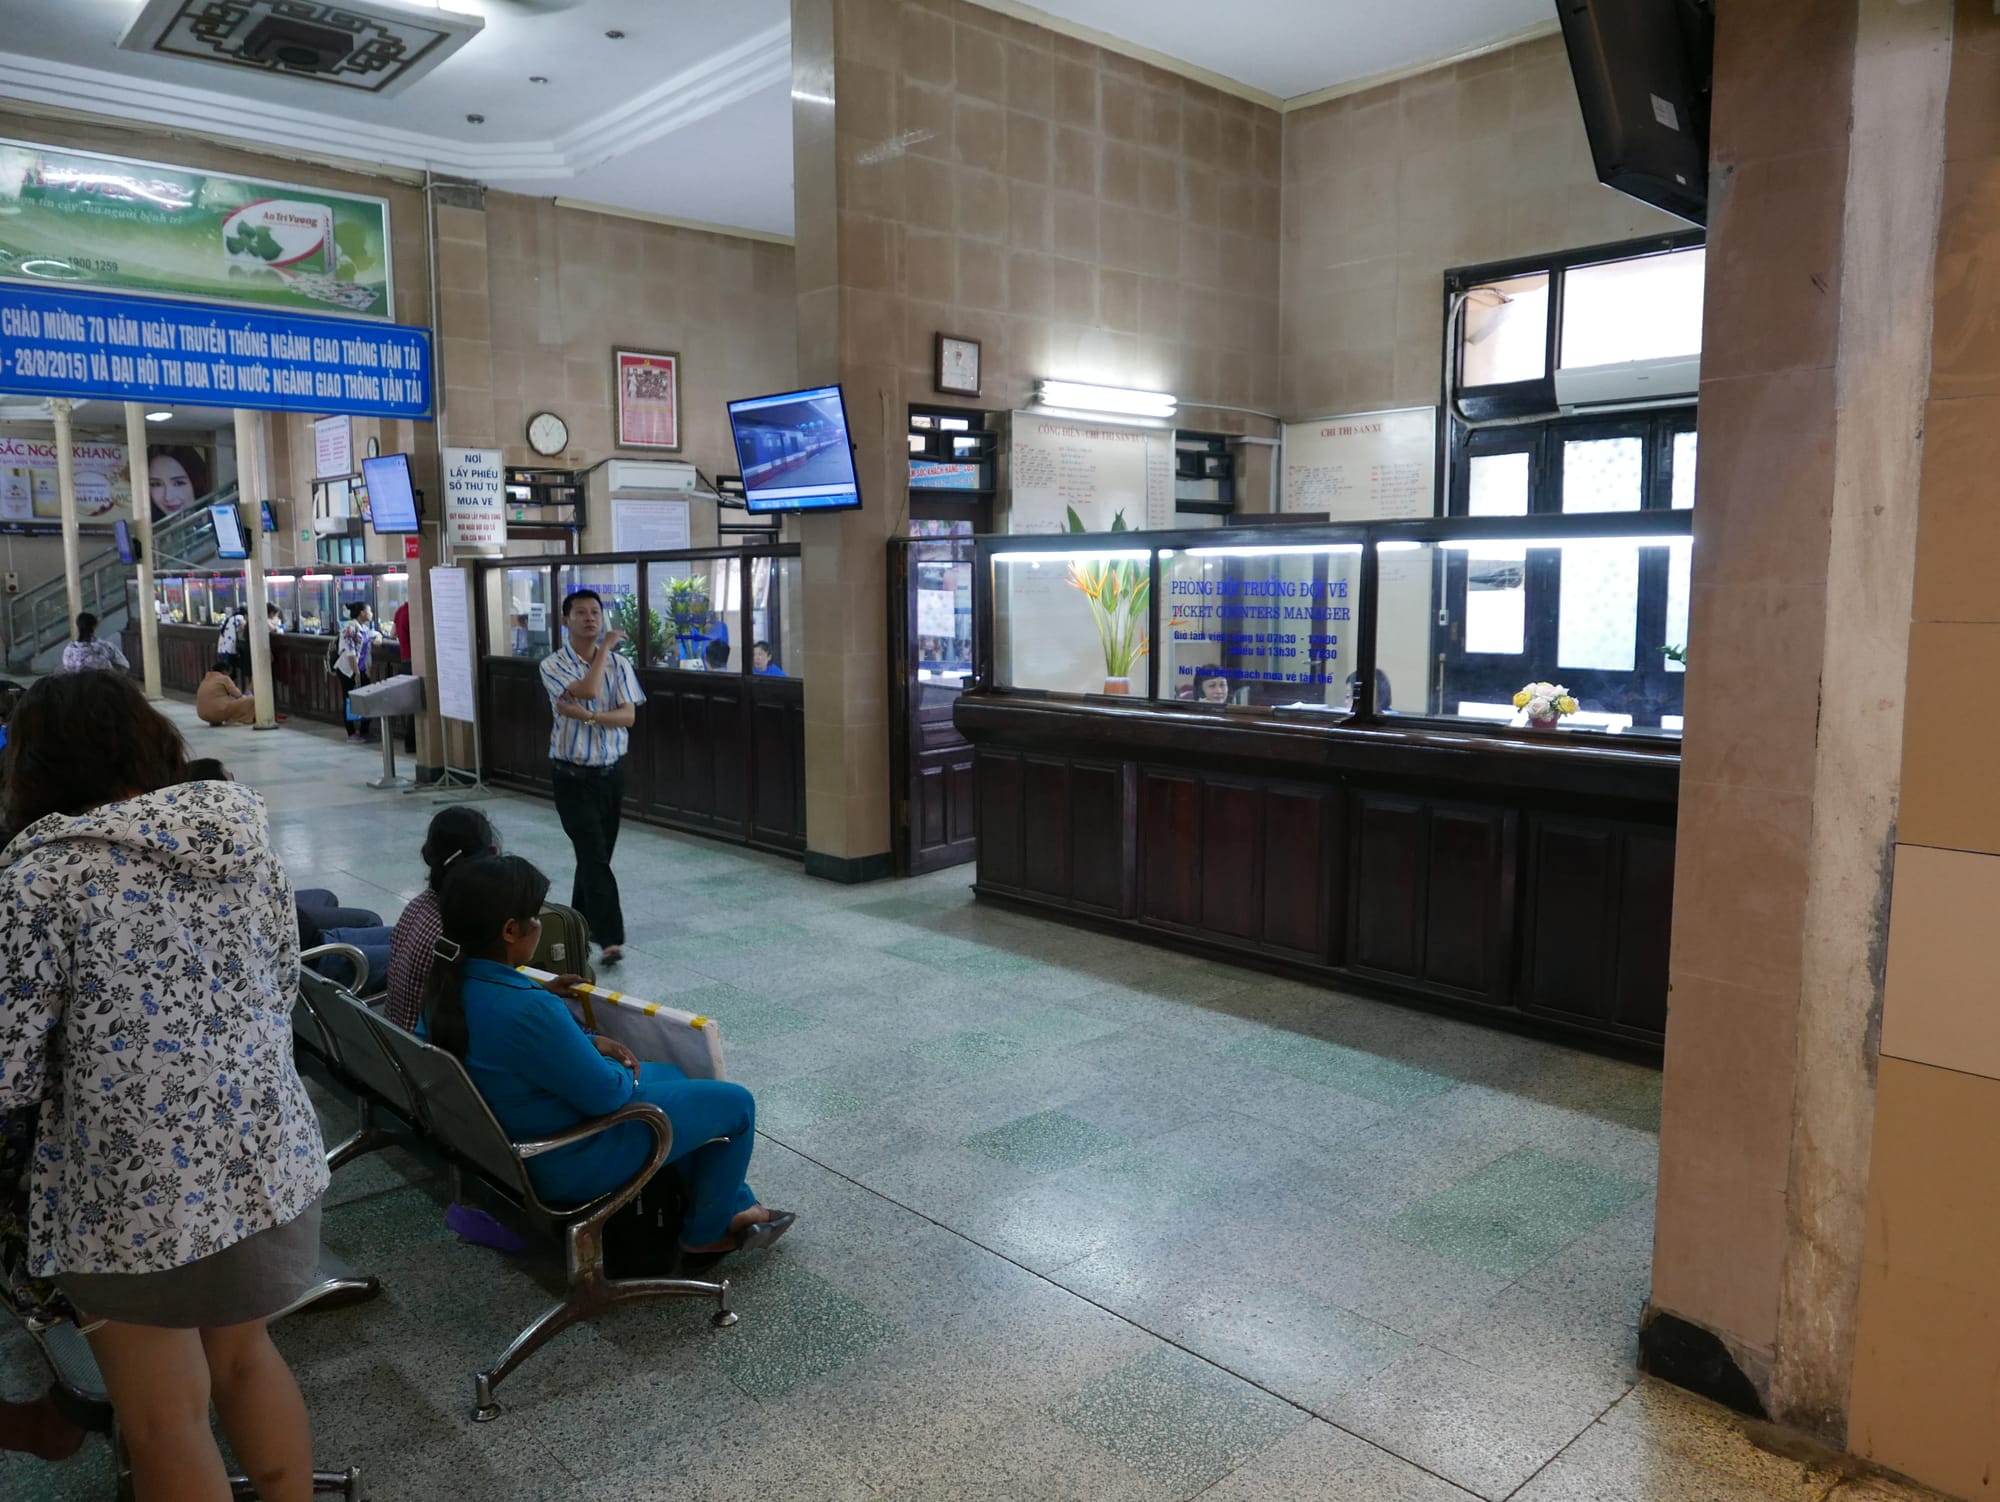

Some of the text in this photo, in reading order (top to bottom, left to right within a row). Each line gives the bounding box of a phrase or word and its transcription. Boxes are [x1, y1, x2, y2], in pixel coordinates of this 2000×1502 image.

[2, 303, 420, 371] CHÀO MỪNG 70 NĂM NGÀY TRUYỀN THỐNG NGÀNH GIAO THÔNG VẬN TẢI
[15, 347, 88, 383] 28/8/2015)
[90, 348, 110, 381] VÀ
[111, 355, 135, 389] ĐẠI
[137, 353, 160, 391] HỘI
[161, 359, 182, 387] THI
[184, 361, 210, 389] ĐUA
[211, 358, 235, 391] YÊU
[237, 361, 271, 393] NƯỚC
[272, 364, 313, 396] NGÀNH
[315, 371, 342, 399] GIAO
[343, 369, 380, 401] THÔNG
[405, 372, 422, 403] TẢI
[72, 445, 122, 460] KHANG
[450, 465, 498, 479] LẤY PHIẾU
[449, 479, 462, 490] SỐ
[457, 496, 494, 506] MUA VÉ
[1171, 576, 1213, 596] PHÒNG
[1243, 575, 1296, 597] TRƯỞNG
[1328, 578, 1348, 598] VÉ
[1172, 605, 1351, 621] TICKET COUNTERS MANAGER
[1267, 632, 1296, 644] 07h30
[1268, 646, 1296, 658] 13h30
[1286, 671, 1297, 682] vé
